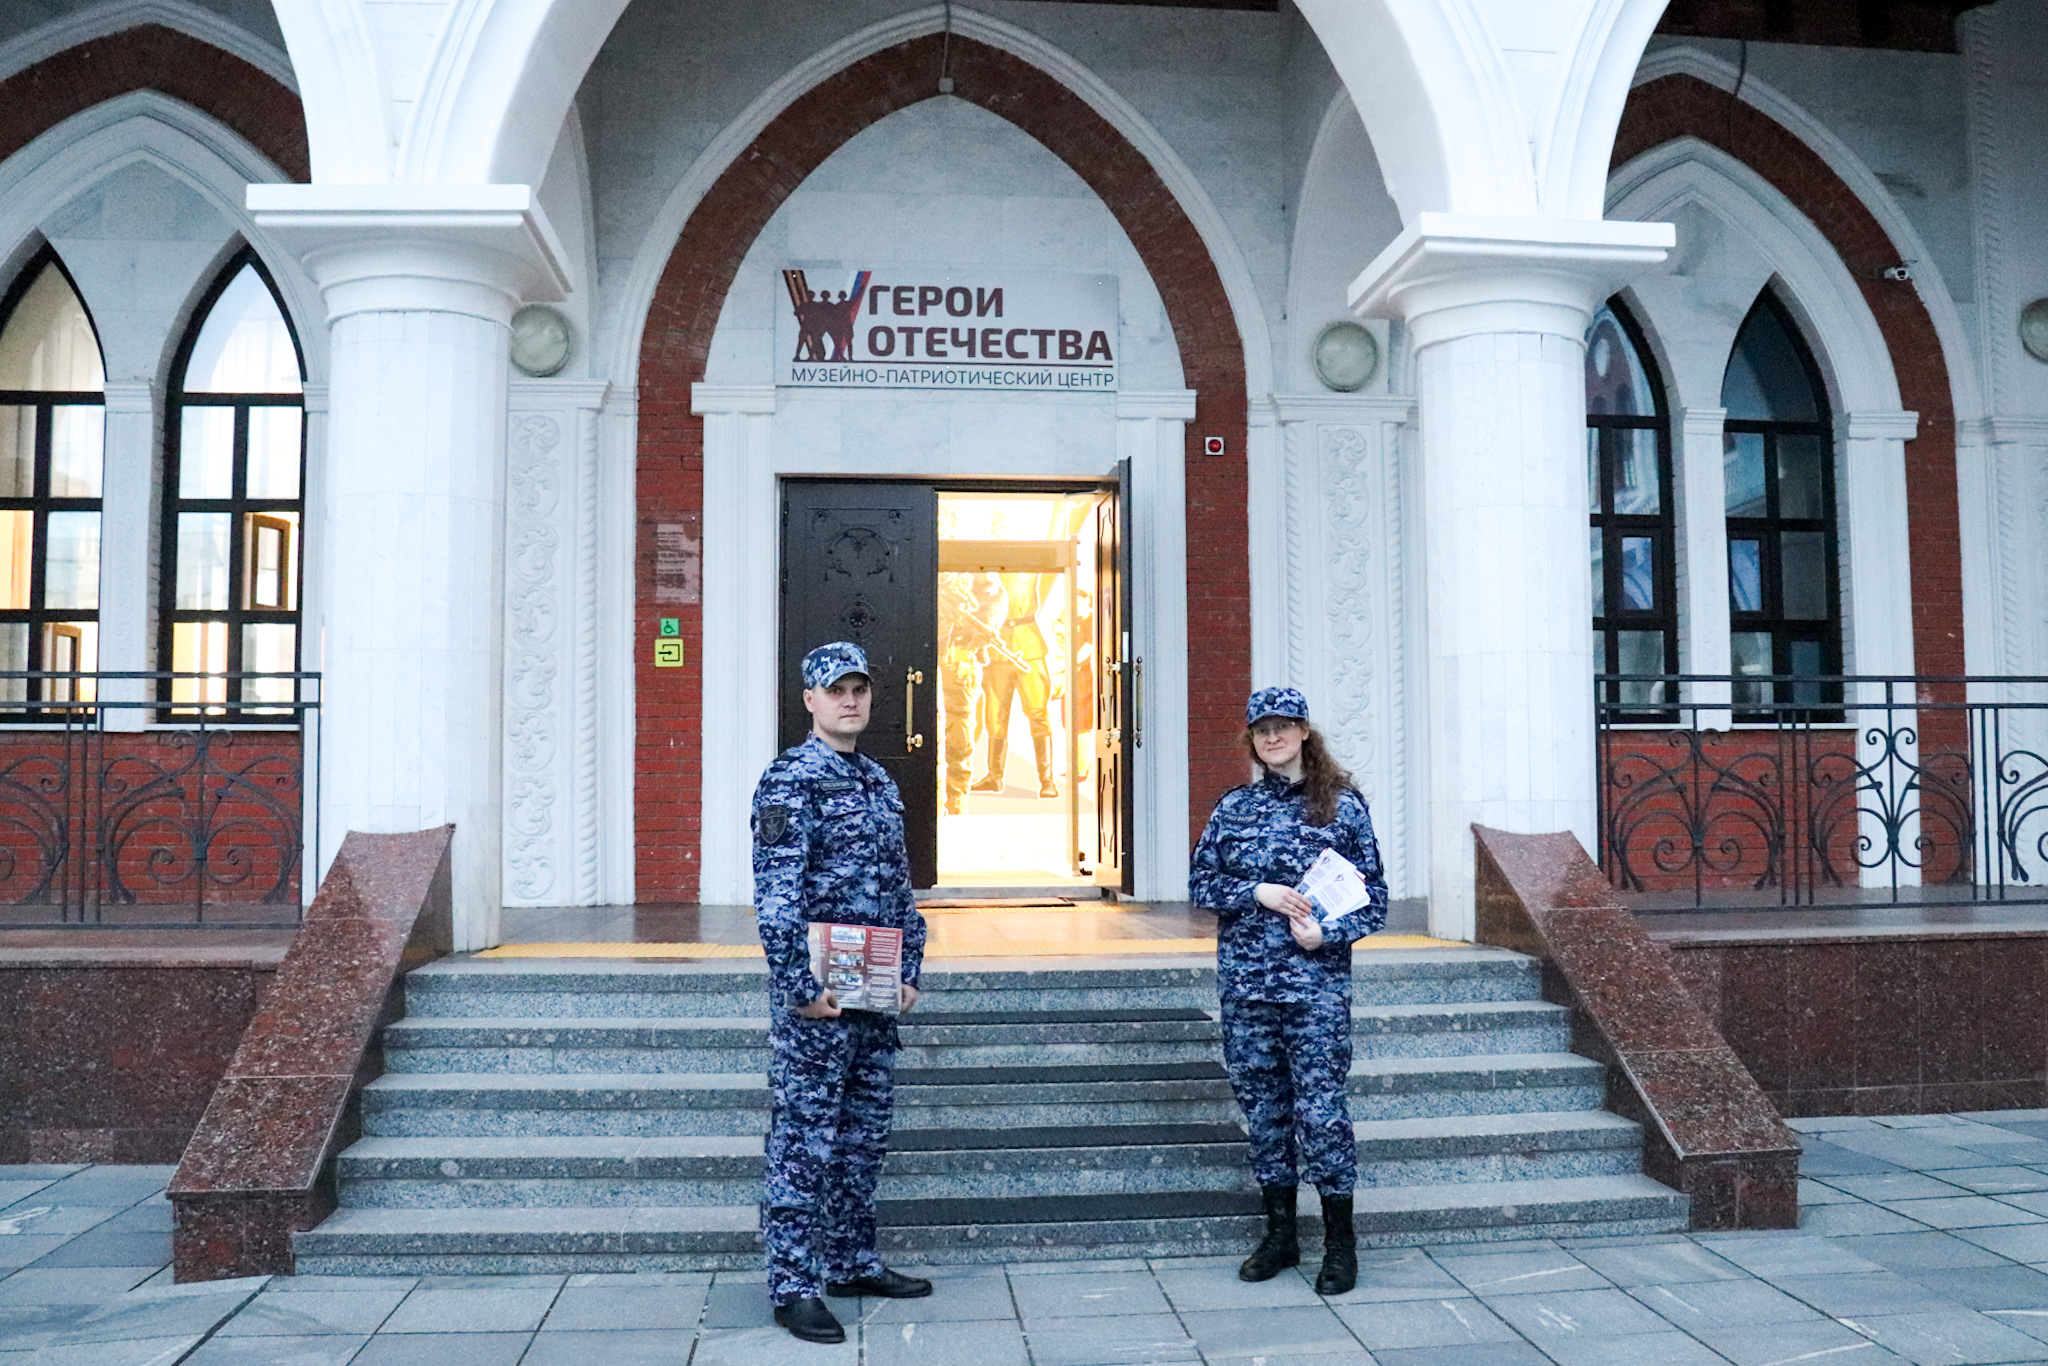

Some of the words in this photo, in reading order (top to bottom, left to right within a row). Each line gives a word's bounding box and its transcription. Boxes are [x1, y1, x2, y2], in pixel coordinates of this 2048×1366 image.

[868, 285, 1003, 317] ГЕРОИ
[867, 325, 1113, 361] ОТЕЧЕСТВА
[791, 365, 1052, 385] МУЗЕЙНО-ПАТРИОТИЧЕСКИЙ
[1058, 372, 1114, 388] ЦЕНТР
